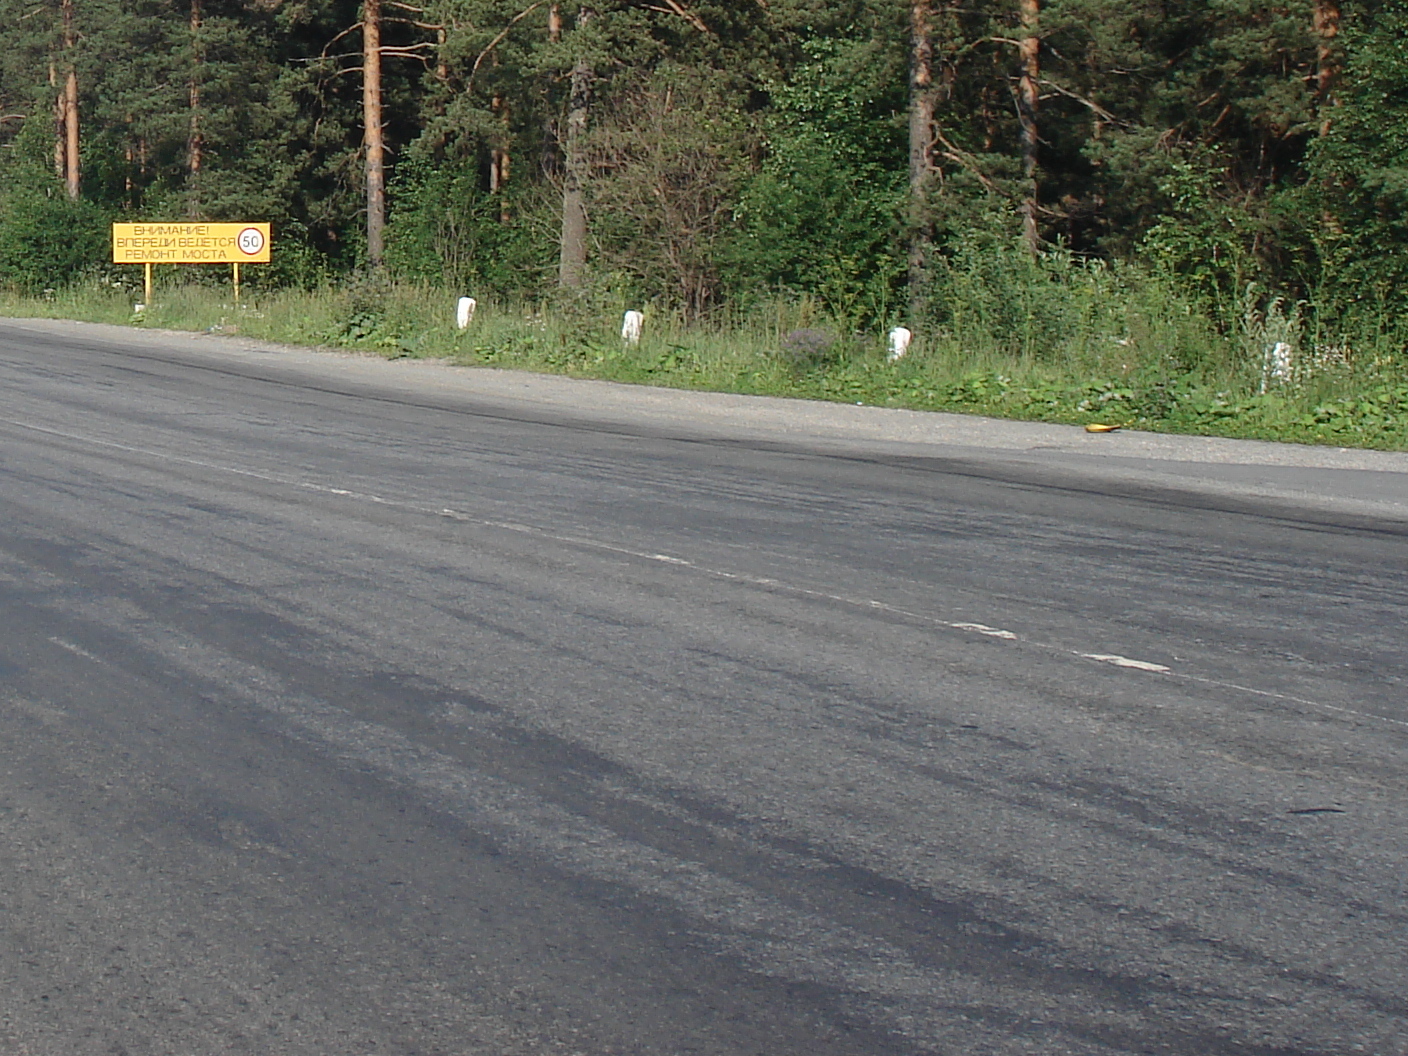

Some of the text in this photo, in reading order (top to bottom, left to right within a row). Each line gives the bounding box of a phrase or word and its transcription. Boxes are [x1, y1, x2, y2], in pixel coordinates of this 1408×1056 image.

[134, 226, 209, 235] ВНИМАНИЕ!
[117, 238, 176, 248] ВПЕРЕДИ
[242, 236, 259, 248] 50
[125, 249, 227, 259] РЕМОНТ МОСТА
